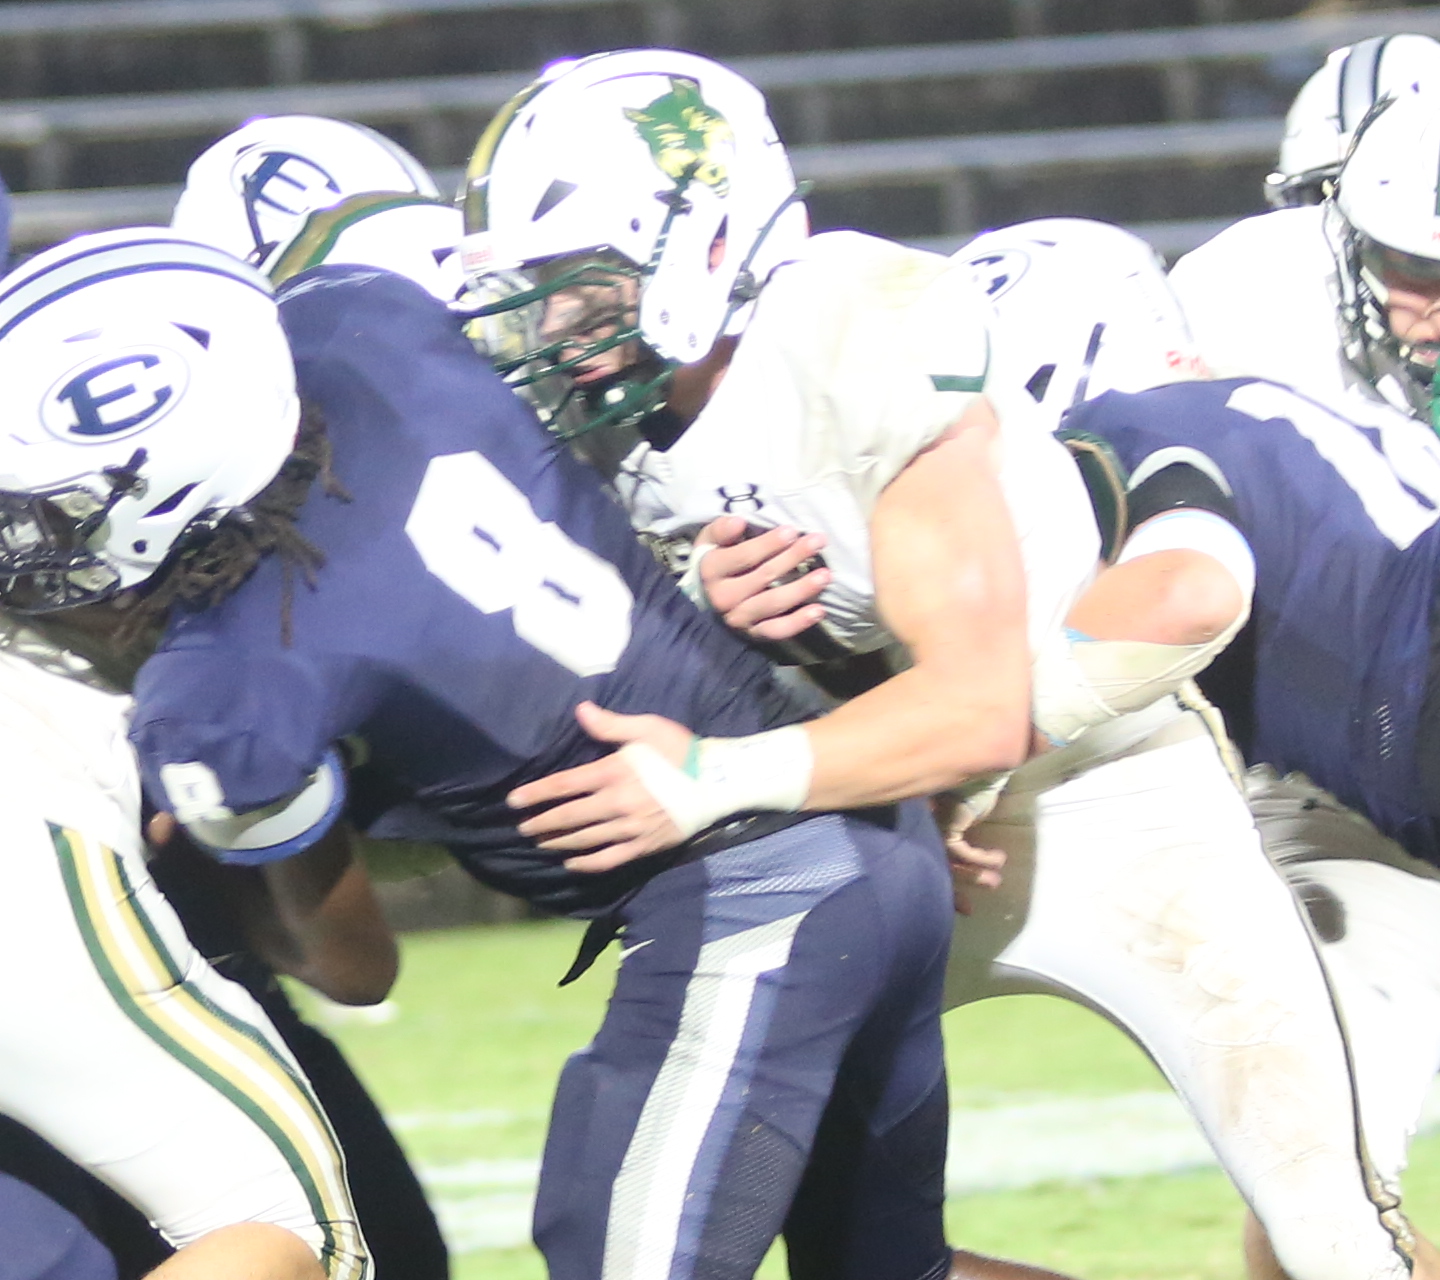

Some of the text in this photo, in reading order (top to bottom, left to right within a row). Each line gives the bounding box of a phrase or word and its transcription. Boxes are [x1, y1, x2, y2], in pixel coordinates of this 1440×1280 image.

[239, 151, 340, 216] E
[57, 354, 170, 436] E
[404, 449, 635, 677] 8
